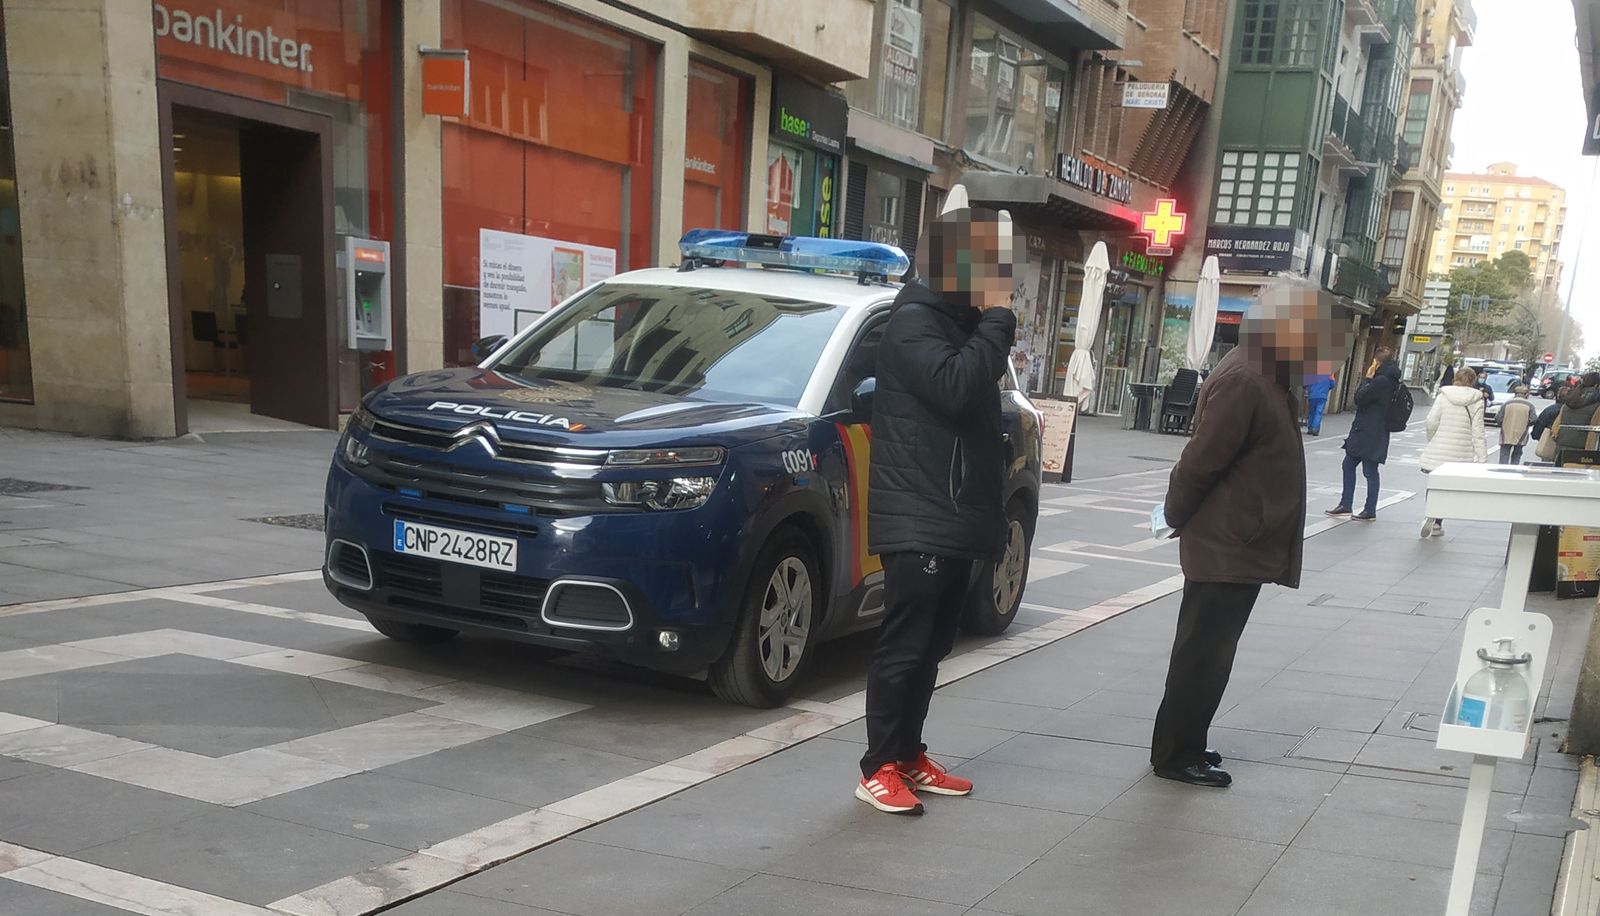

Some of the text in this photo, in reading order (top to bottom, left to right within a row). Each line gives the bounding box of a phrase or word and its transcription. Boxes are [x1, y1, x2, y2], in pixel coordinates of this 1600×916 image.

[1062, 154, 1093, 189] HERALDO
[1207, 238, 1232, 250] MARCOS
[1272, 241, 1290, 252] ROJO
[397, 526, 514, 567] E CNP2428RZ
